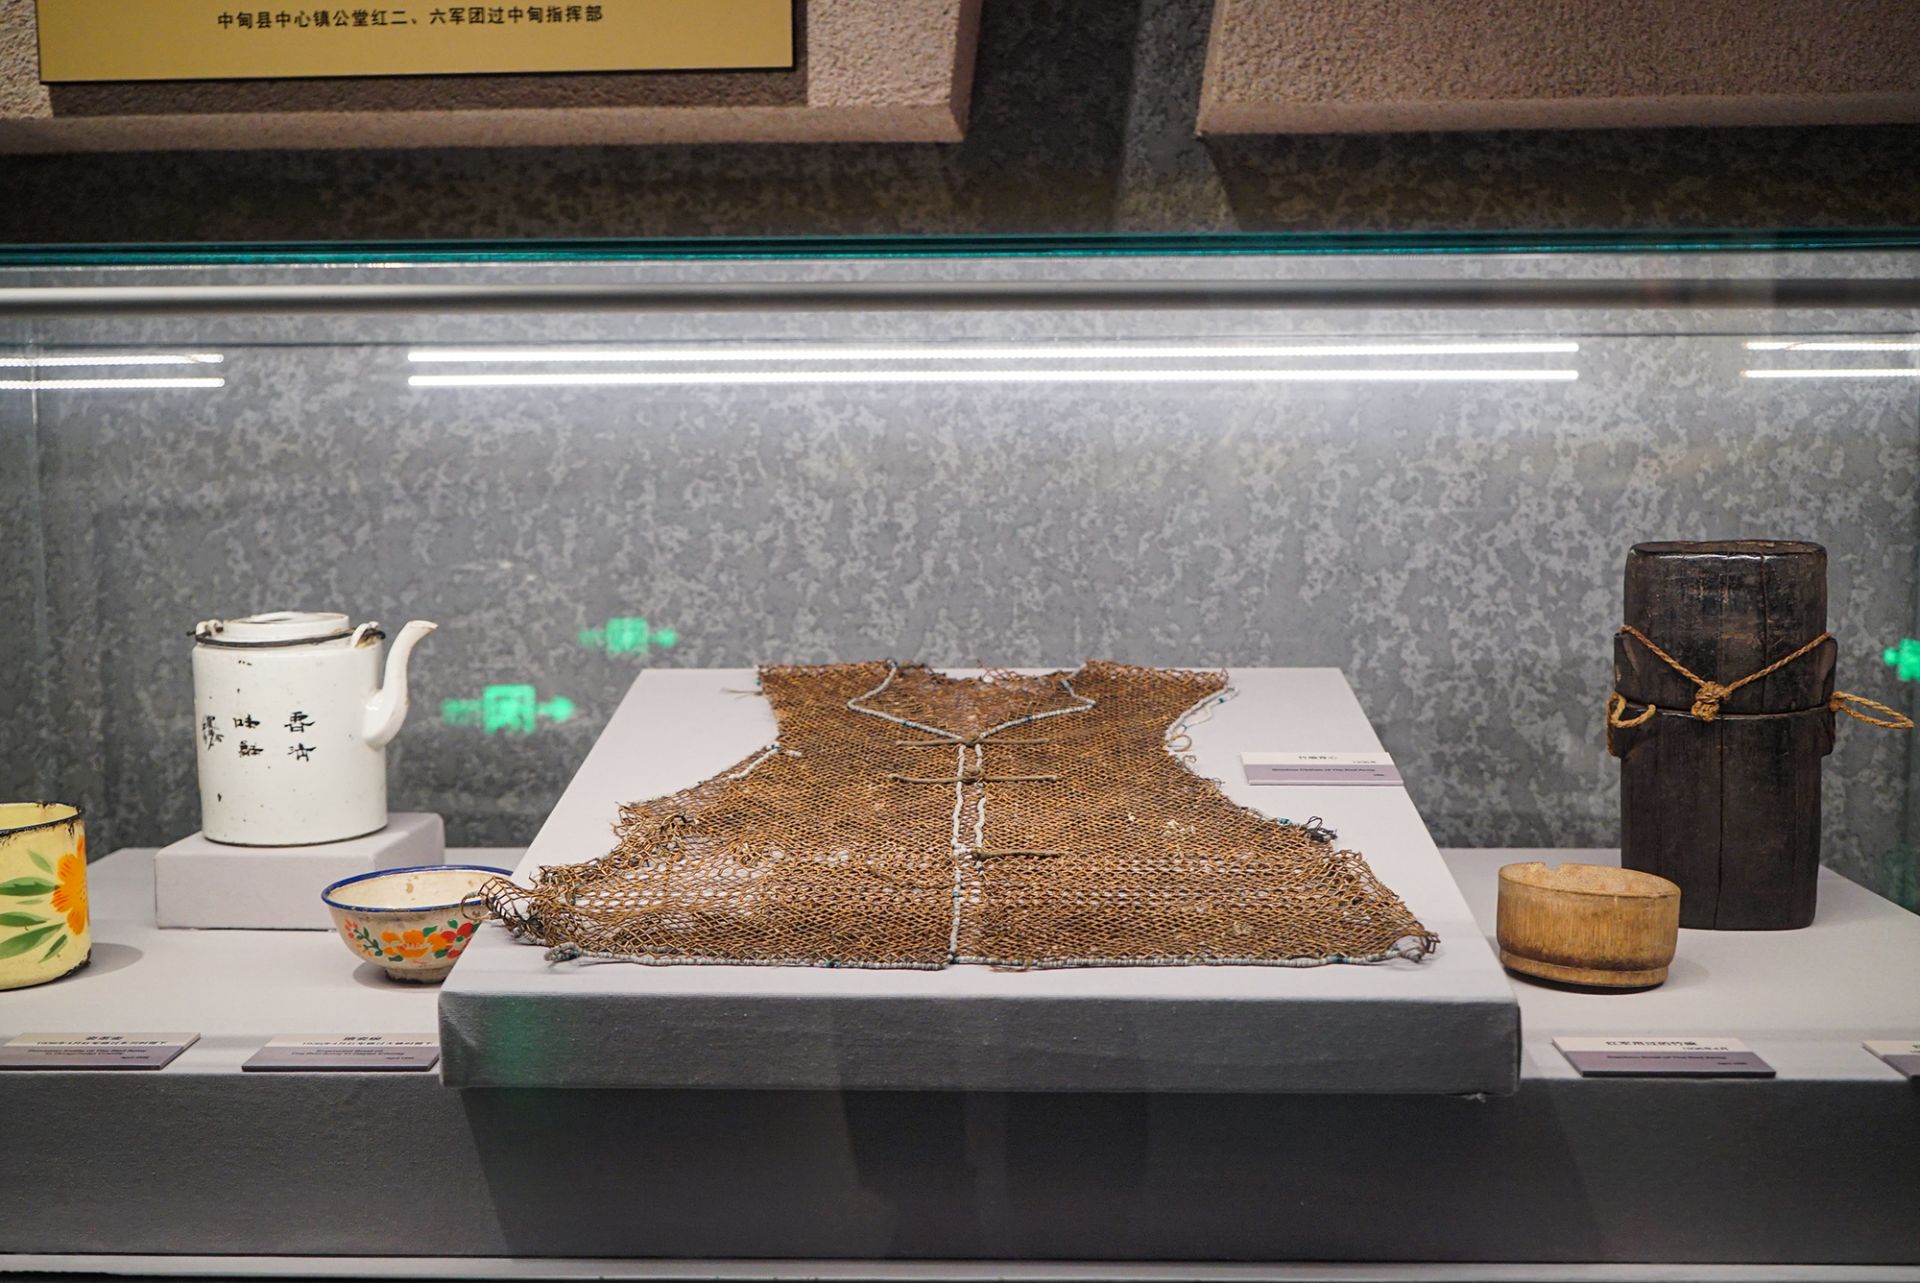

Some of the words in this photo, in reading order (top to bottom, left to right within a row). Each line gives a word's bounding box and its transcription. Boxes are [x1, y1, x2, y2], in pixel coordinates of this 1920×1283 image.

[217, 5, 603, 29] 中甸县中心镇公堂红二、六军团过中甸指挥部
